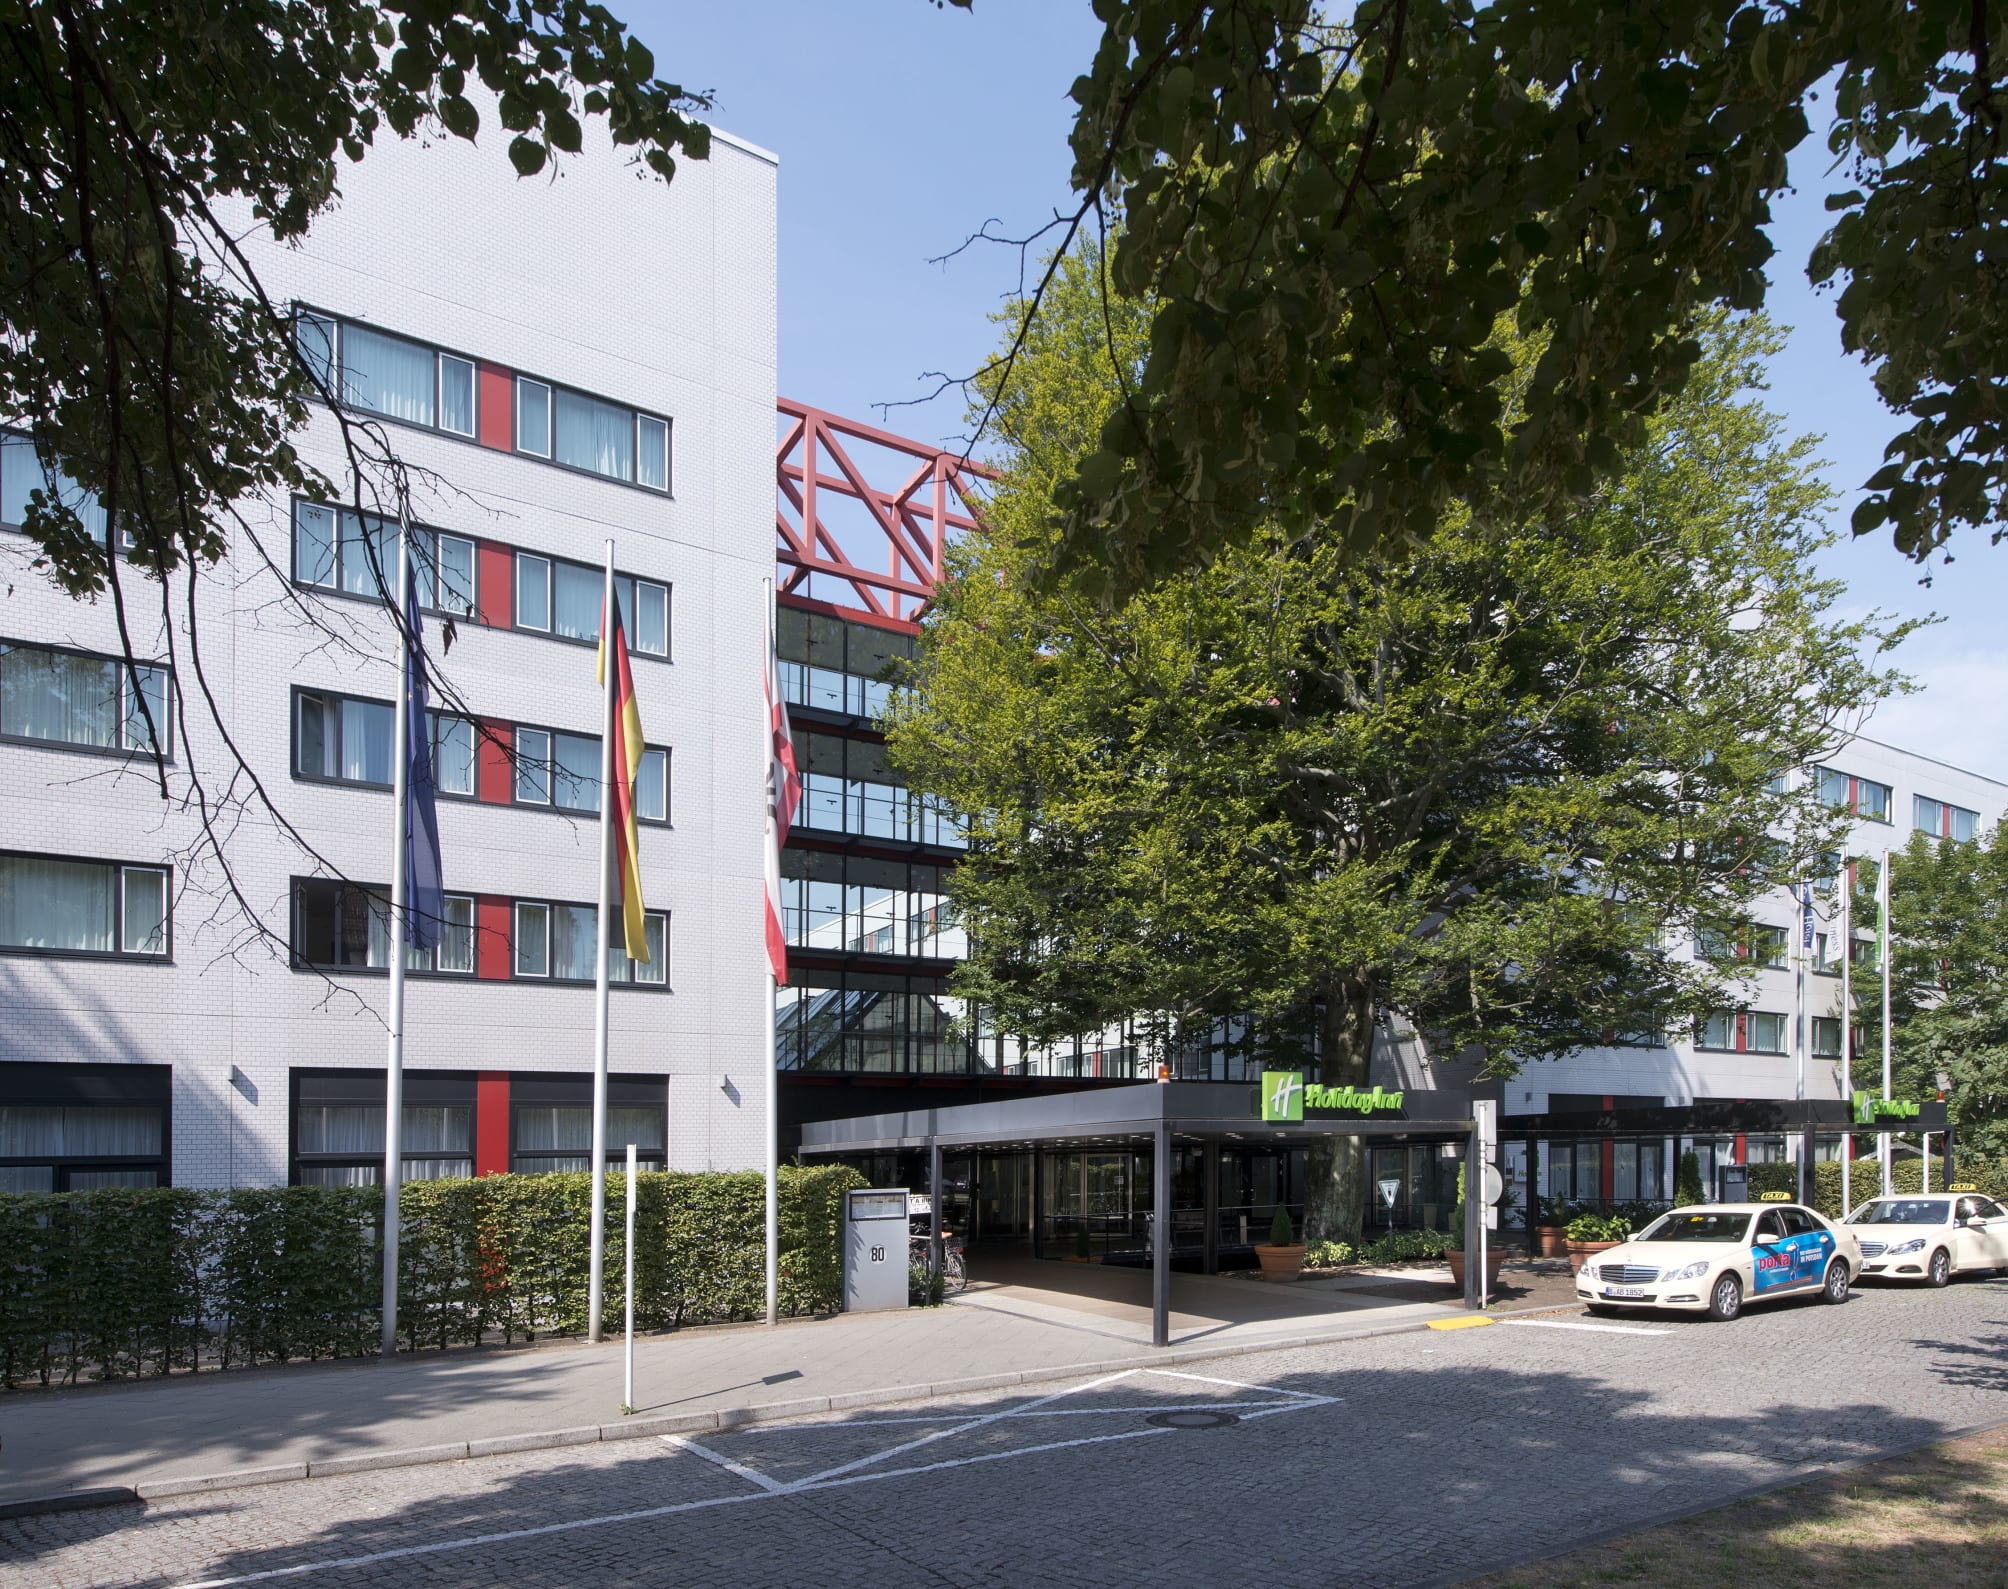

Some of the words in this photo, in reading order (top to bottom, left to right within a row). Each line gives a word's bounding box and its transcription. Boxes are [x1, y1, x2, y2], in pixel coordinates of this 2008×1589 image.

[1304, 1083, 1373, 1115] Holiday
[1372, 1085, 1404, 1110] Inn
[871, 1247, 885, 1262] 80
[1759, 1252, 1791, 1272] porta
